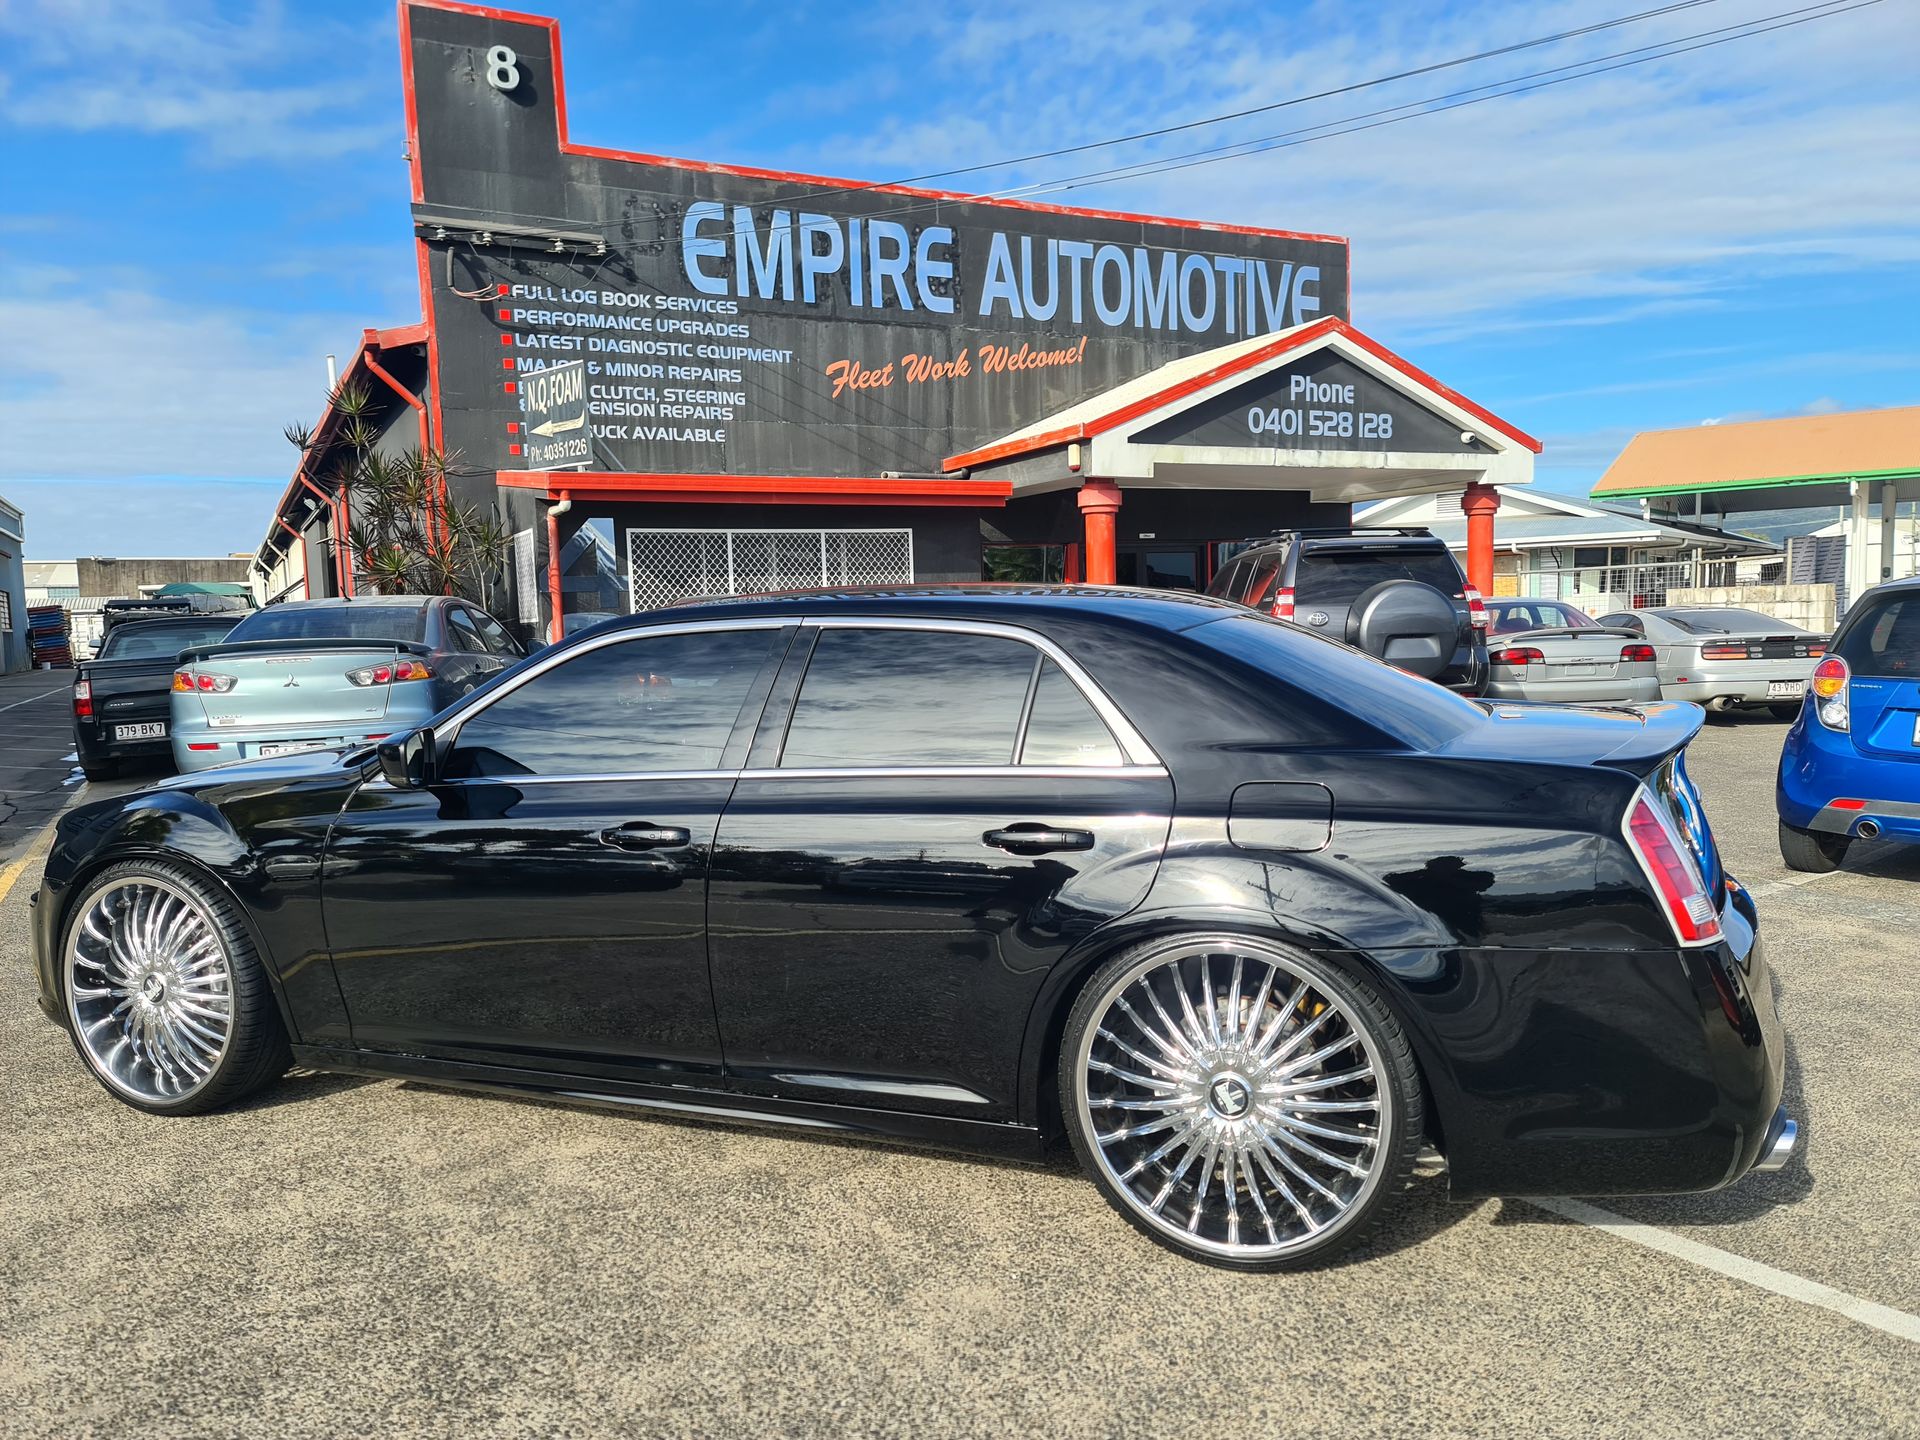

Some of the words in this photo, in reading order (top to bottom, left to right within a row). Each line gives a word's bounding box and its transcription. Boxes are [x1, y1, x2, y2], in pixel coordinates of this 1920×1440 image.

[487, 45, 520, 90] 8
[682, 201, 955, 314] EMPIRE
[979, 232, 1321, 335] AUTOMOTIVE
[511, 284, 558, 301] FULL
[561, 288, 598, 305] LOG
[601, 291, 651, 308] BOOK
[655, 295, 738, 314] SERVICES
[513, 308, 653, 331] PERFORMANCE
[656, 319, 750, 338] UPGRADES
[515, 333, 584, 350] LATEST
[588, 338, 694, 357] DIAGNOSTIC
[697, 345, 793, 364] EQUIPMENT
[587, 361, 601, 375] &
[605, 362, 664, 379] MINOR
[668, 365, 742, 383] REPAIRS
[826, 359, 894, 399] Fleet
[901, 348, 972, 384] Work
[978, 335, 1088, 375] Welcome!
[590, 385, 660, 404] CLUTCH,
[663, 388, 746, 406] STEERING
[1290, 374, 1355, 405] Phone
[660, 404, 734, 421] REPAIRS
[1248, 406, 1303, 436] 0401
[1309, 410, 1353, 438] 528
[1358, 412, 1393, 439] 128
[543, 438, 588, 461] 40351226
[632, 426, 726, 443] AVAILABLE
